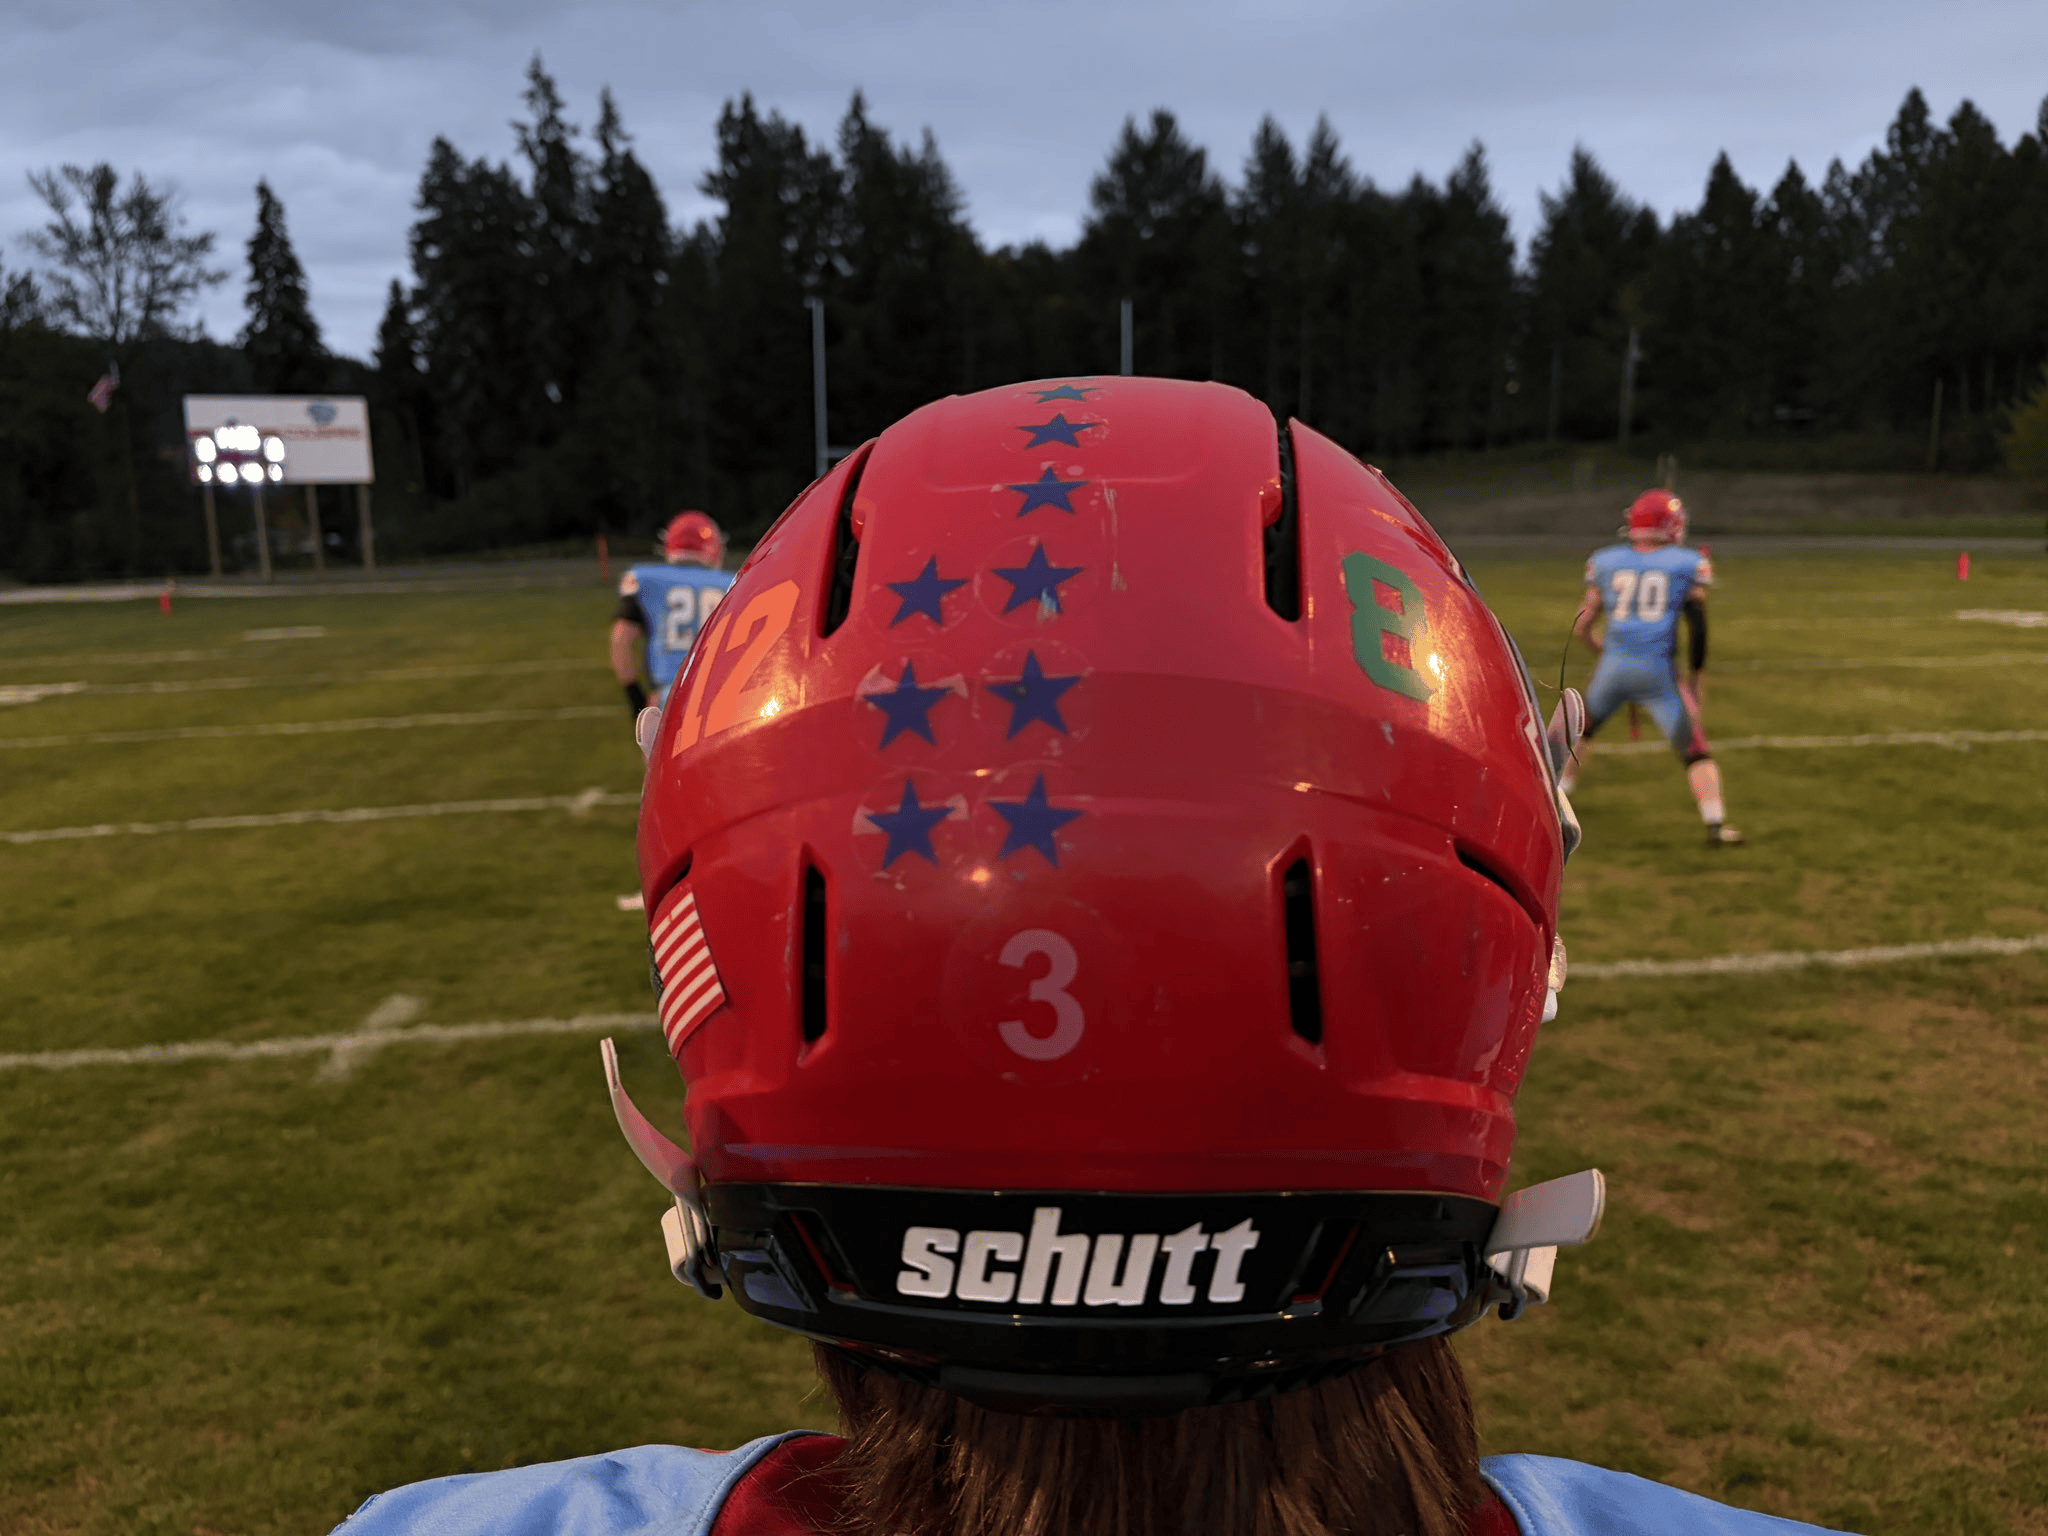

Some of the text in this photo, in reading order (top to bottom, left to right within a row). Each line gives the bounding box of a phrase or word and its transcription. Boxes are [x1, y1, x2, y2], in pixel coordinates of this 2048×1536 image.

[1342, 551, 1440, 704] 8
[1610, 569, 1668, 623] 70
[671, 578, 800, 759] 12
[998, 928, 1085, 1061] 3
[897, 1207, 1260, 1306] schutt
